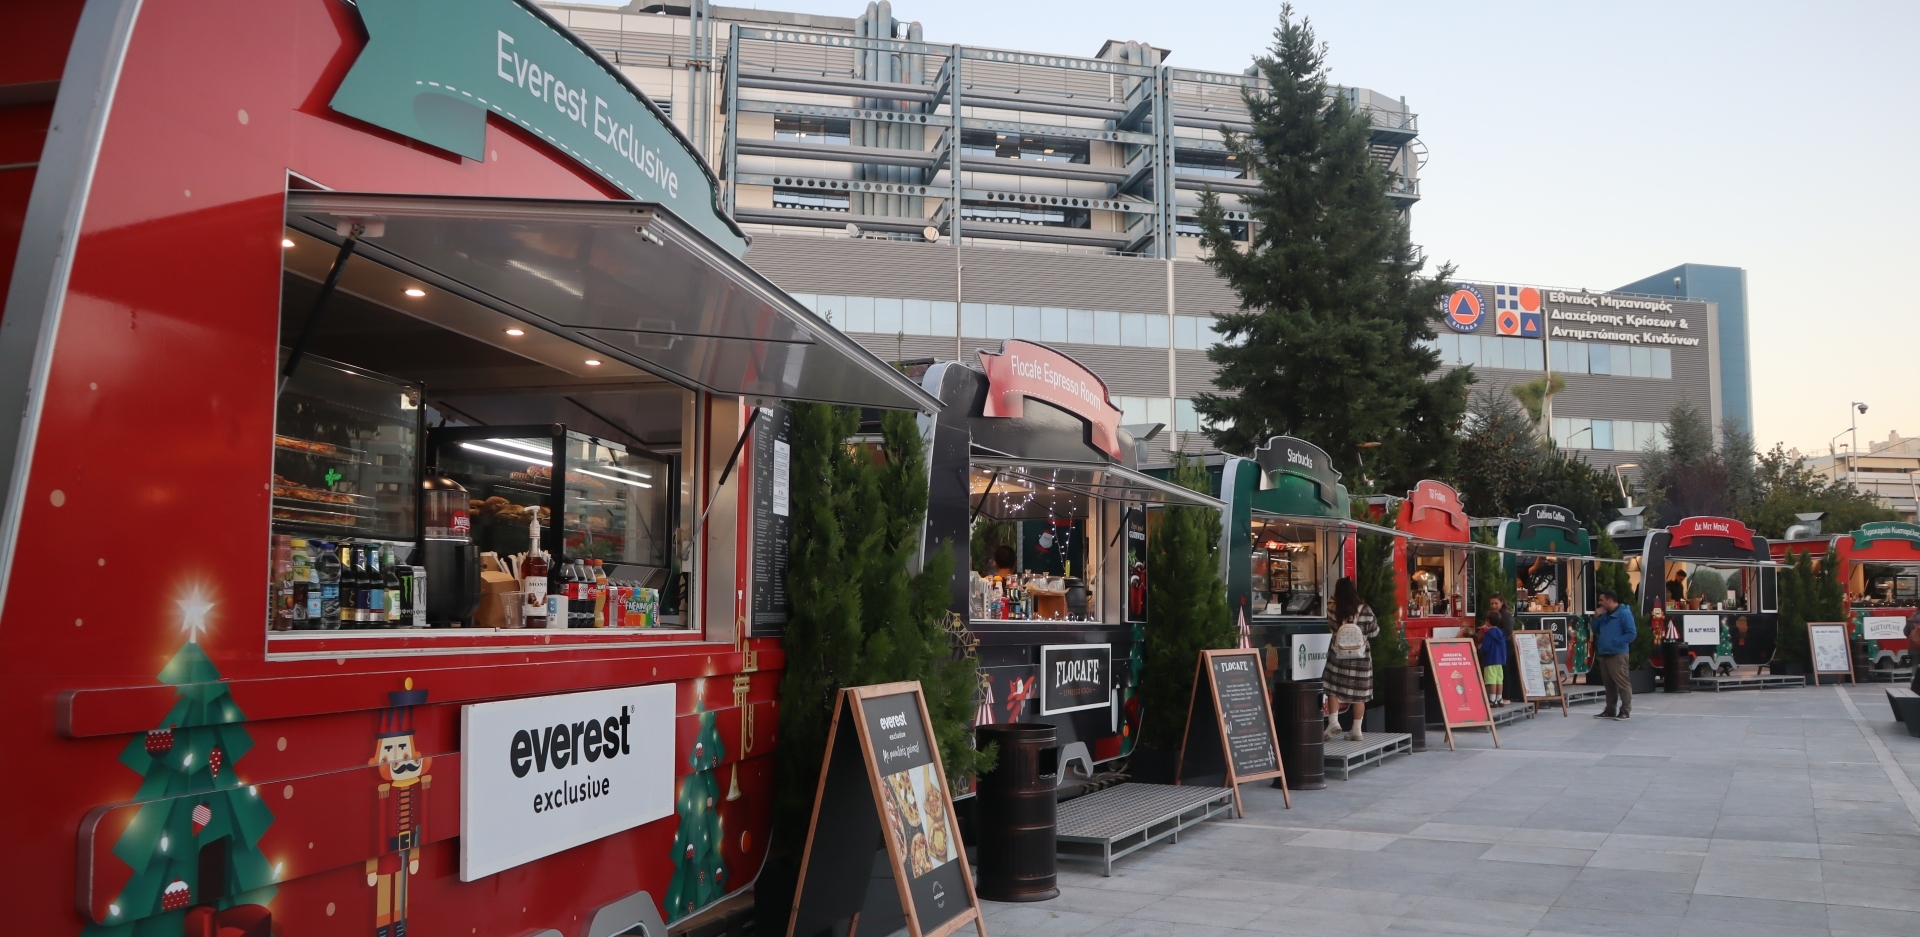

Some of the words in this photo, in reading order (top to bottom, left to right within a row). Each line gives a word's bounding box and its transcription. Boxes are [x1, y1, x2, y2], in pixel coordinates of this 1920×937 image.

[497, 30, 588, 128] Everest
[594, 95, 679, 198] Exclusive
[1550, 292, 1598, 308] Εθνικός
[1601, 296, 1673, 314] Μηχανισμός
[1452, 321, 1478, 331] ΕΛΛΑΔΑ
[1551, 309, 1623, 326] Διαχείρισης
[1626, 313, 1677, 329] Κρίσεων
[1680, 319, 1689, 329] &
[1552, 326, 1640, 344] Αντιμετώπισης
[1643, 331, 1699, 346] Κινδύνων
[1011, 355, 1042, 380] Flocafe
[1044, 362, 1079, 396] Espresso
[1080, 381, 1101, 411] Room
[1287, 448, 1313, 469] Starbucks
[1552, 510, 1566, 522] Coffee
[1056, 659, 1100, 689] FLOCAFE
[1221, 660, 1249, 673] FLOCAFE
[880, 711, 908, 730] everest
[510, 705, 631, 779] everest
[533, 774, 611, 814] exclusive
